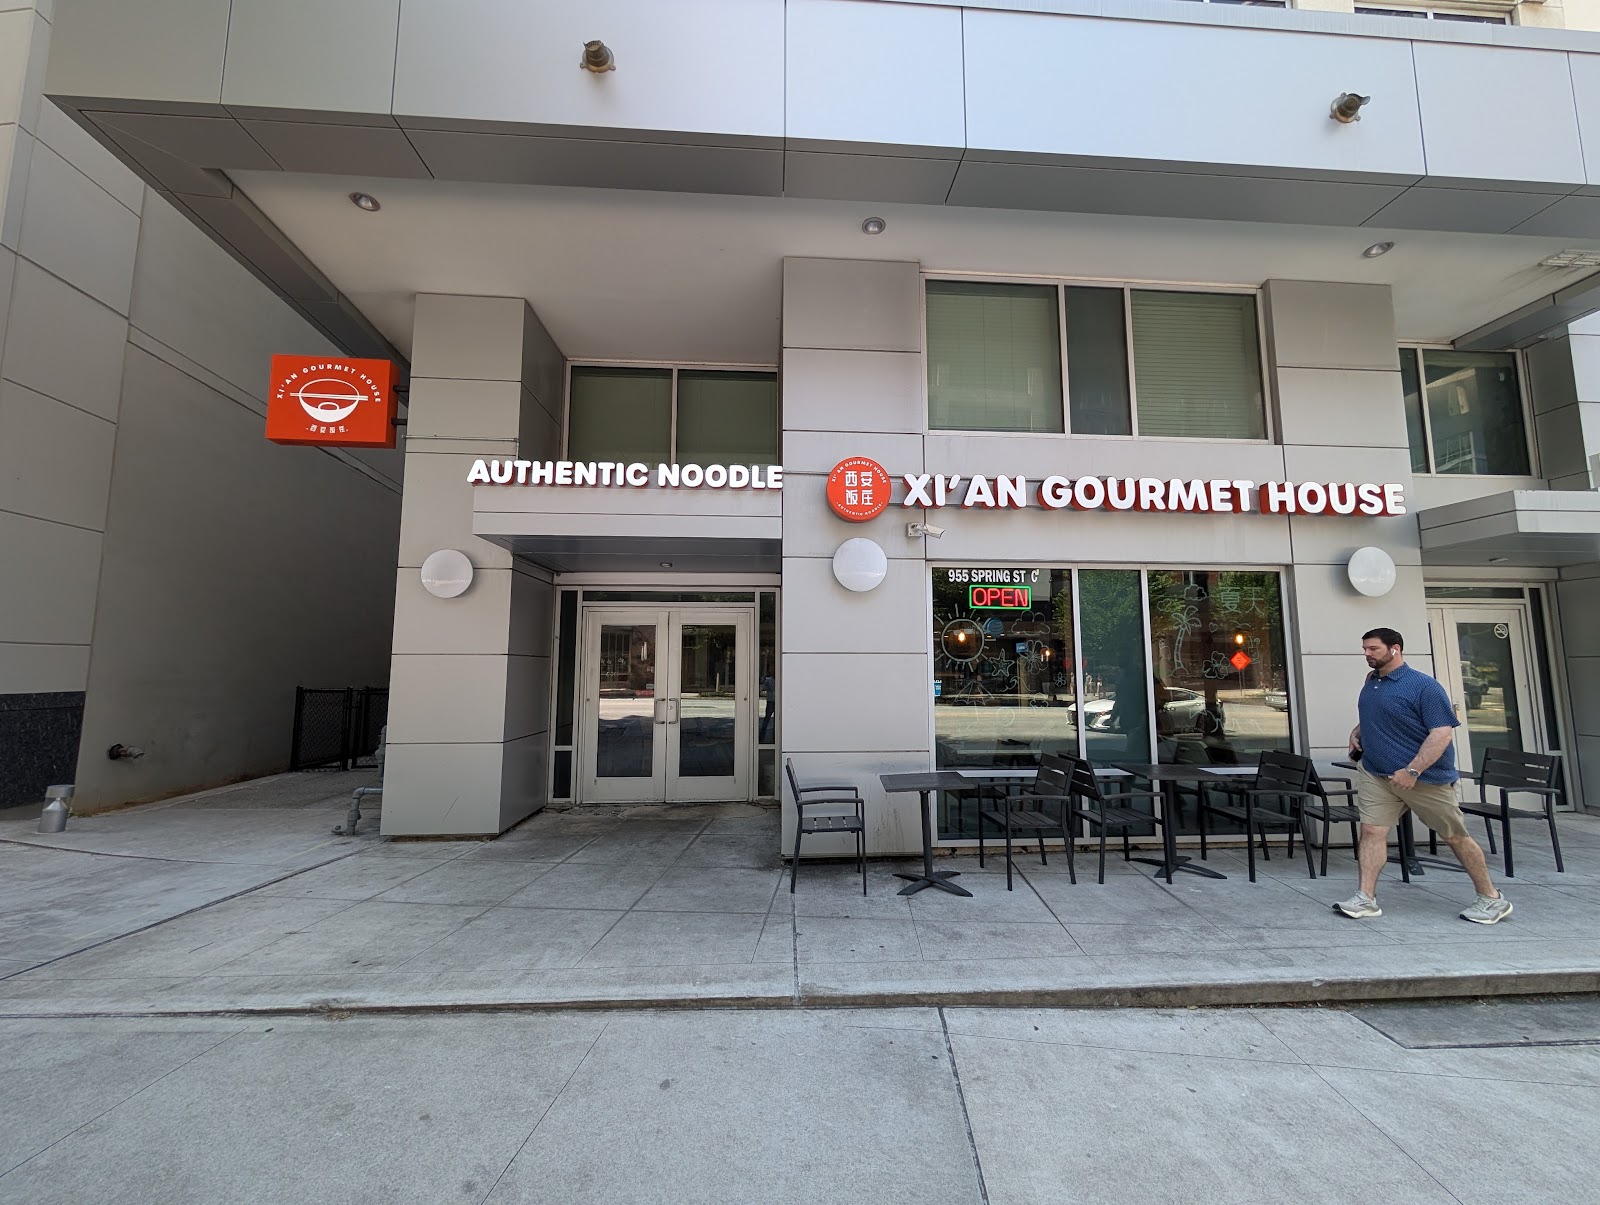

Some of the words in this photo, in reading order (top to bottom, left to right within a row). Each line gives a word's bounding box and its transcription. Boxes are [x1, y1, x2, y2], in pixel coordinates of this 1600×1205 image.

[277, 373, 297, 399] XI'AN
[302, 363, 356, 374] GOURMET
[360, 374, 381, 402] HOUSE
[467, 459, 648, 486] AUTHENTIC
[657, 463, 783, 489] NOODLE
[845, 470, 873, 487] 西安
[903, 473, 1027, 508] XI'AN
[1041, 476, 1255, 513] GOURMET
[1268, 480, 1407, 516] HOUSE
[948, 569, 969, 583] 955
[971, 569, 1011, 583] SPRING
[1013, 570, 1026, 583] ST
[972, 587, 1029, 607] OPEN
[1220, 586, 1264, 614] 夏天
